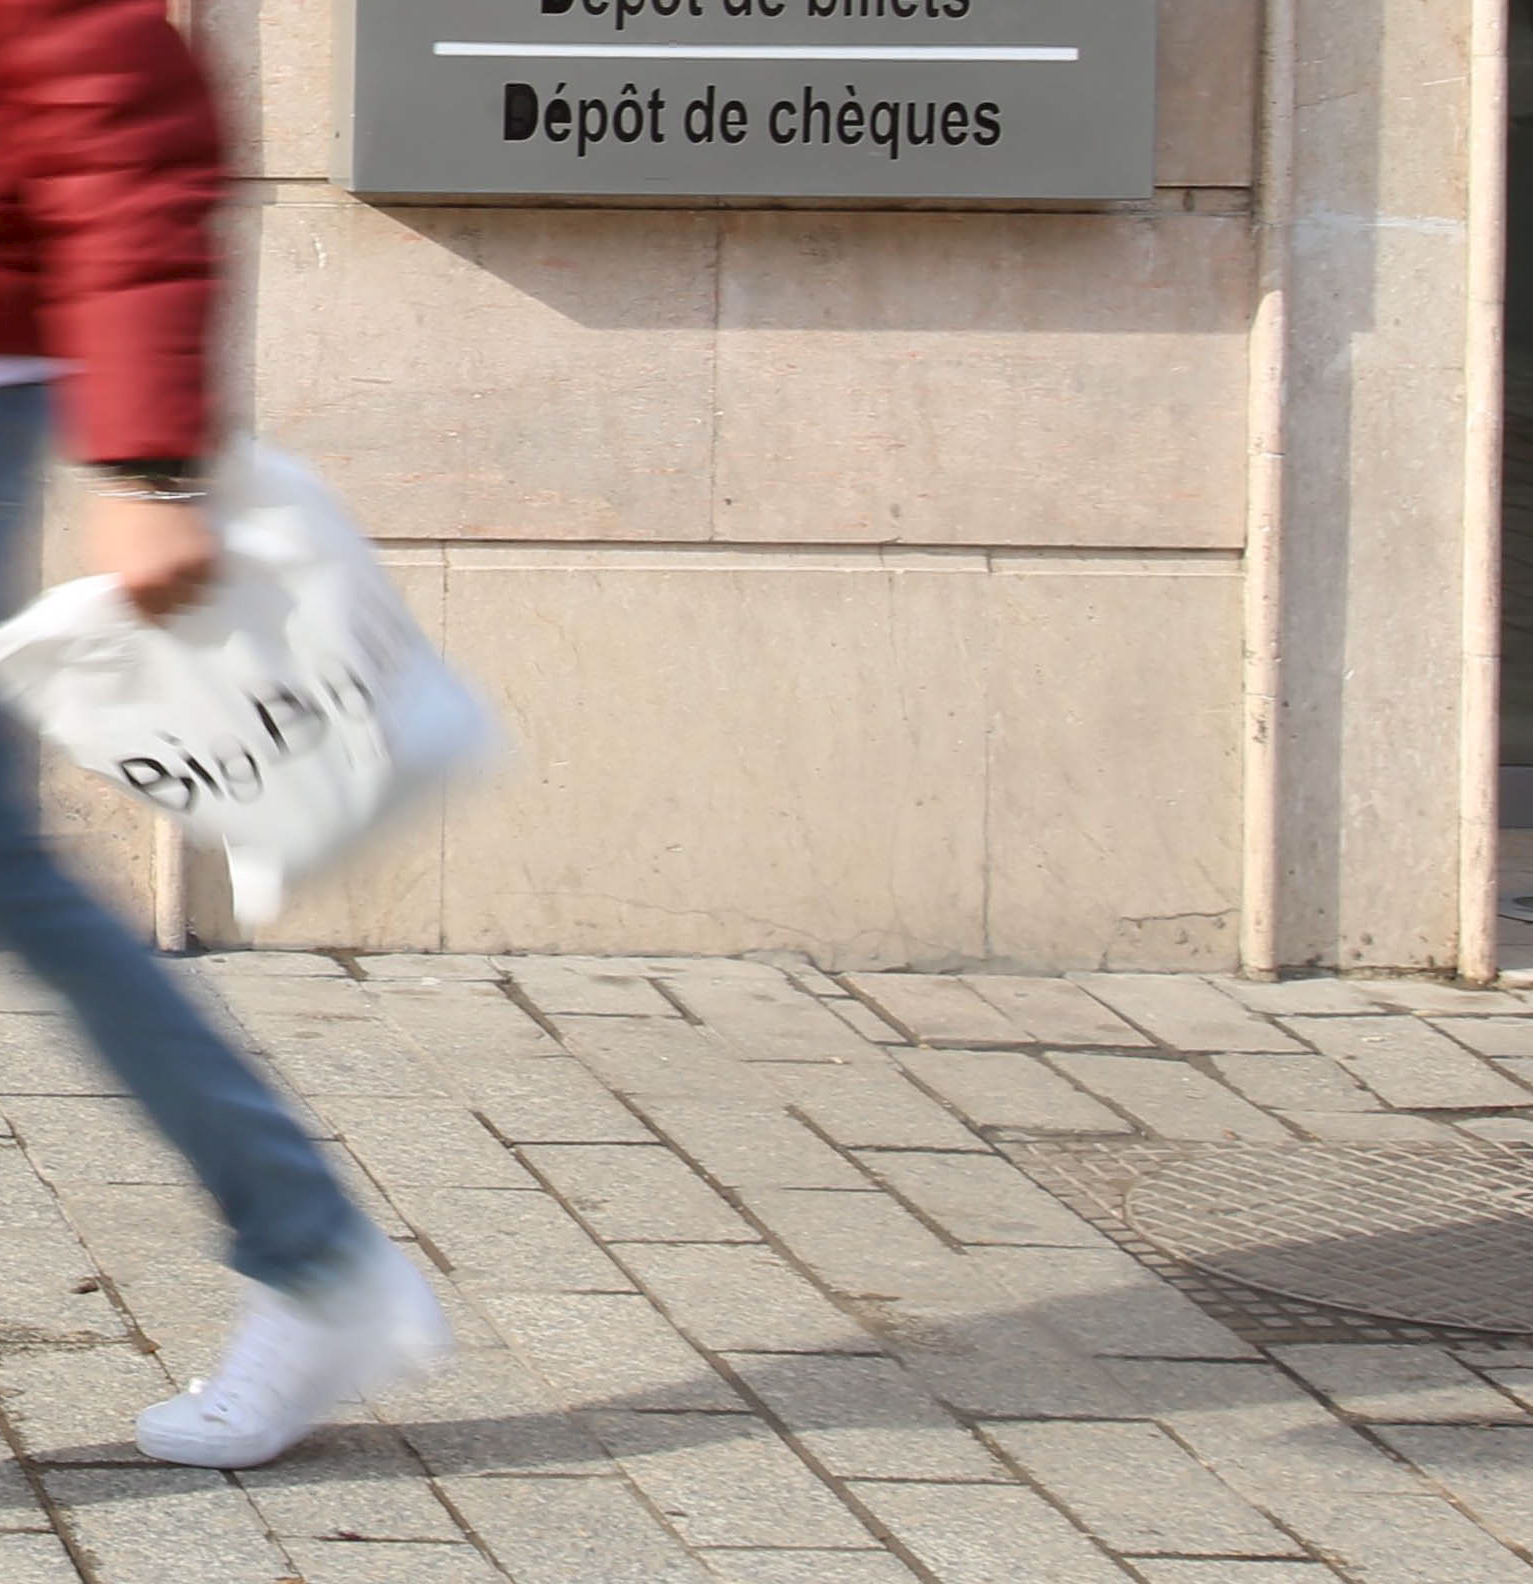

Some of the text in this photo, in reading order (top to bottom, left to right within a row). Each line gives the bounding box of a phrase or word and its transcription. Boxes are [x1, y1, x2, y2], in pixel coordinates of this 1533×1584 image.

[503, 82, 1001, 160] Dépôt de chèques
